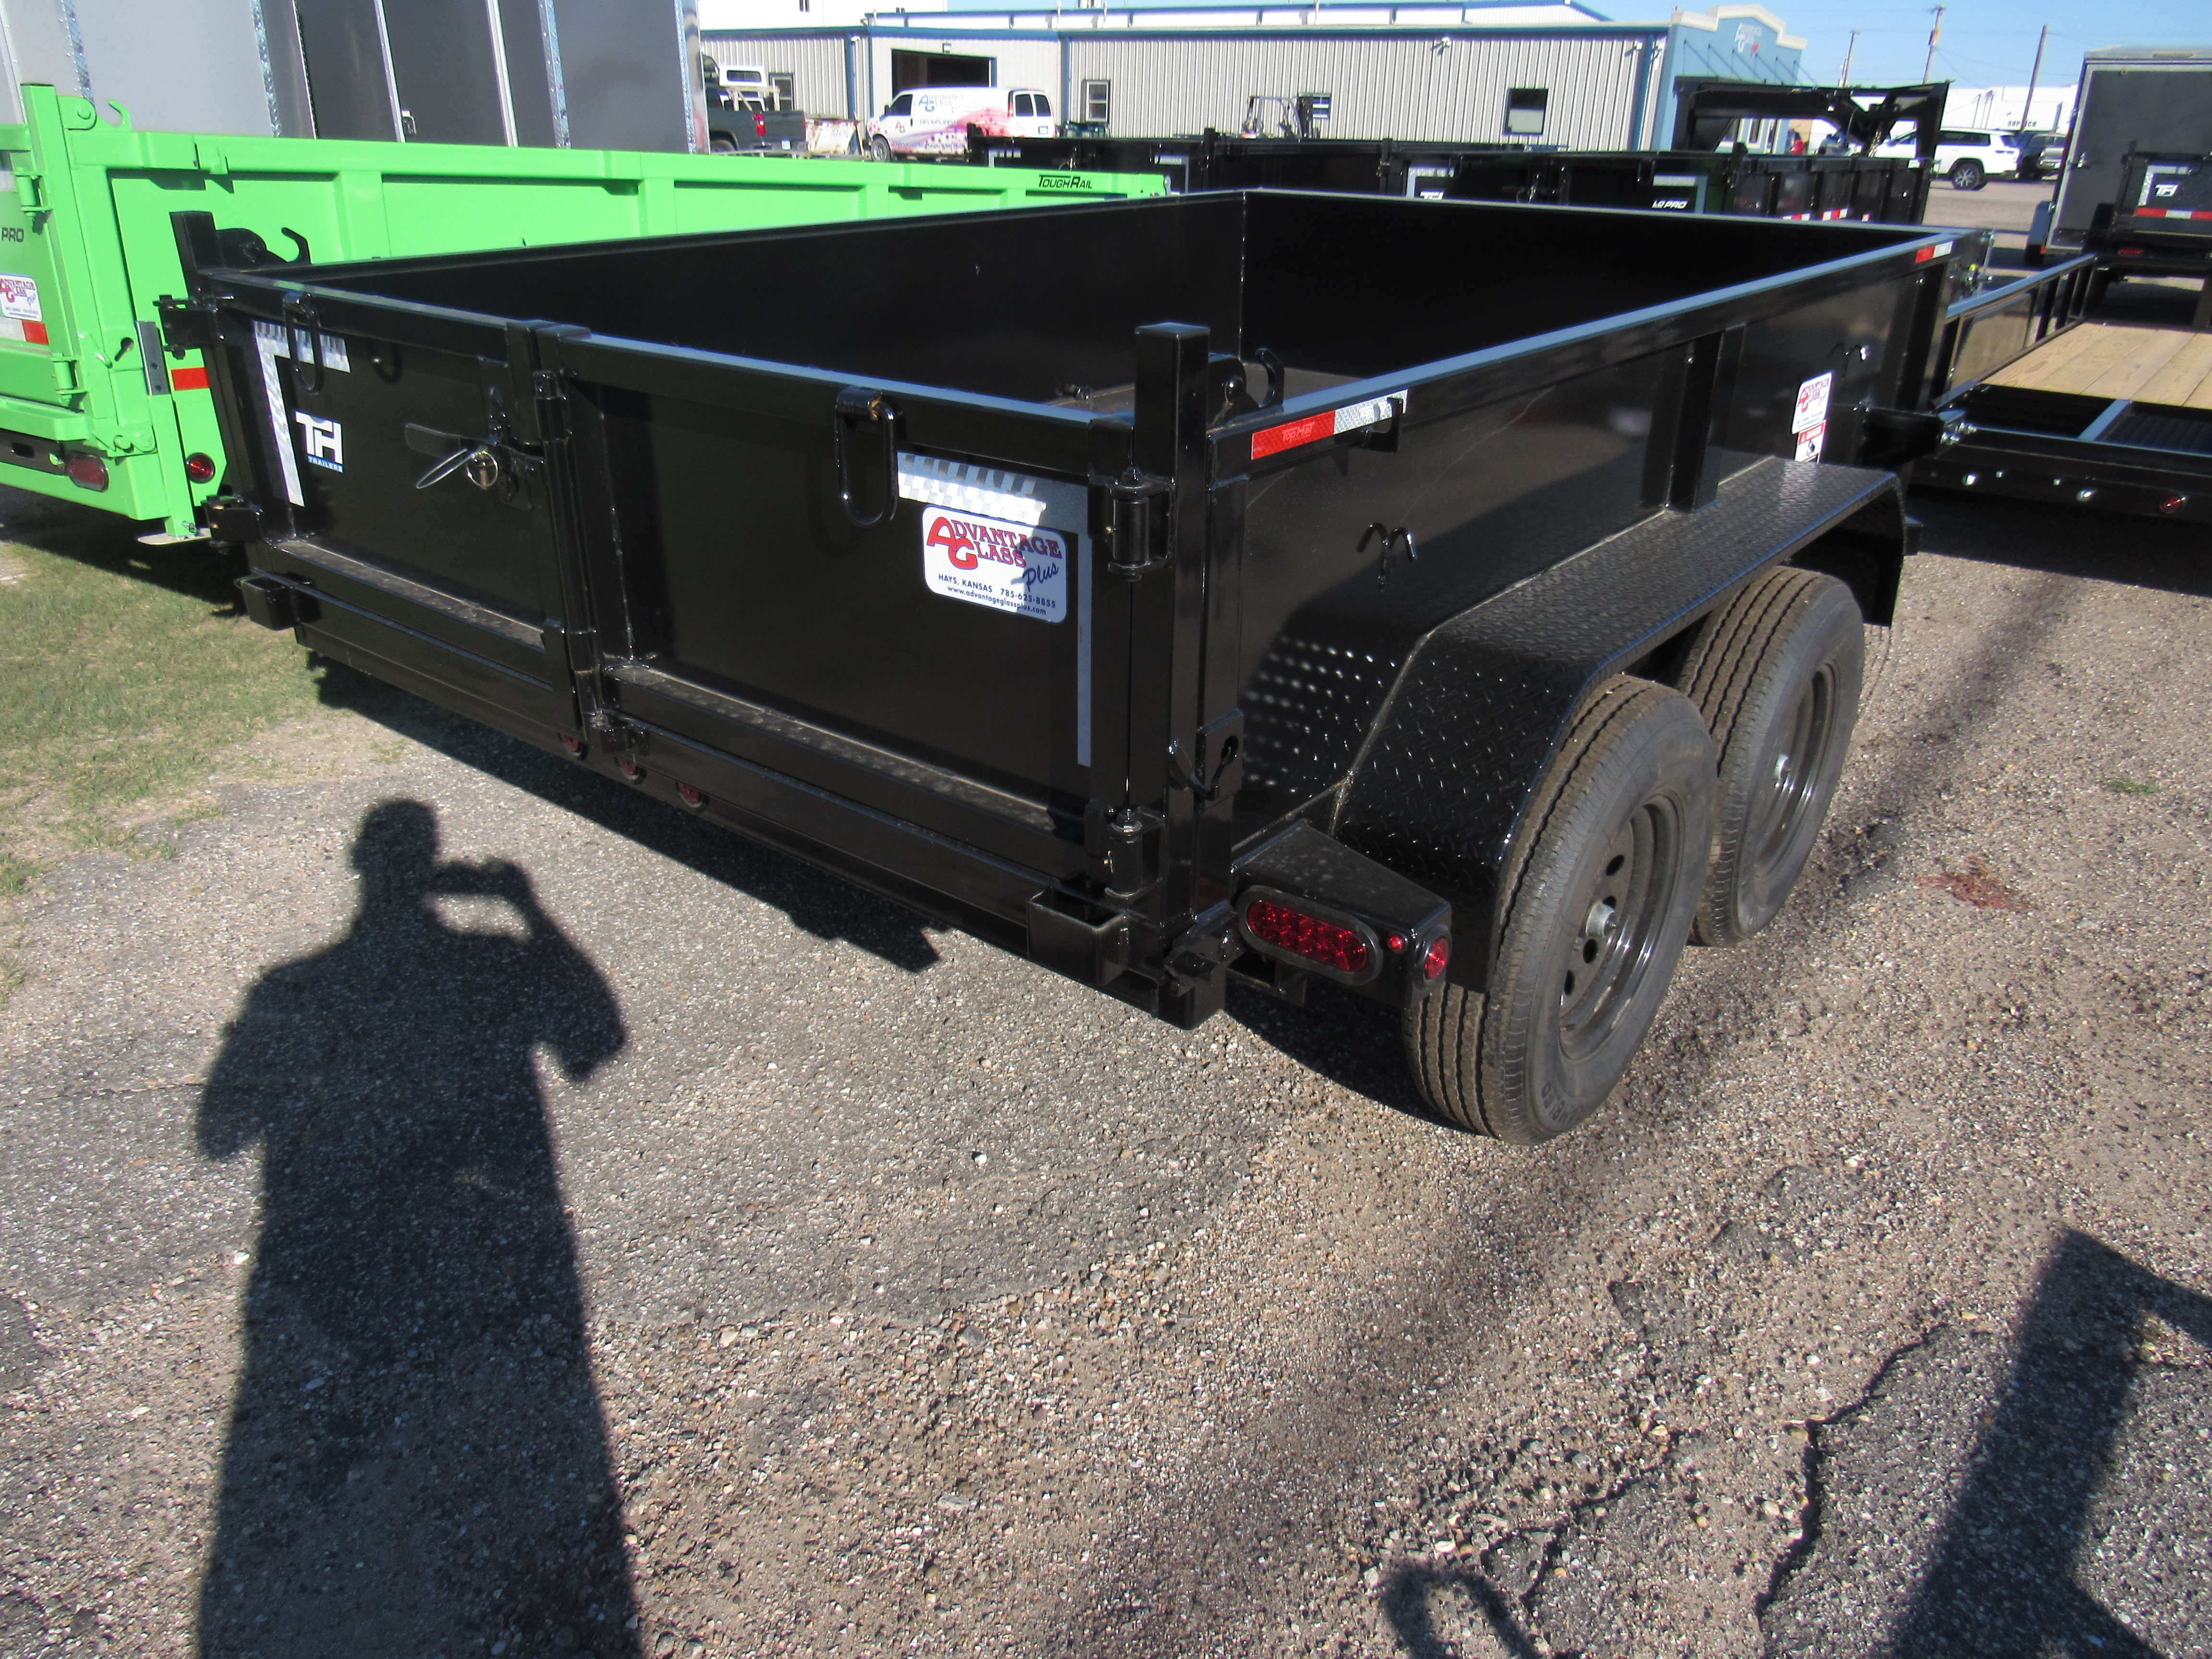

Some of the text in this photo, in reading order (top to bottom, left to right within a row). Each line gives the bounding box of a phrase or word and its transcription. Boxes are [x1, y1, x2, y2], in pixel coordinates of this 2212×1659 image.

[1663, 201, 1688, 209] PRO
[1, 227, 24, 242] PRO
[295, 410, 343, 465] TH
[308, 456, 344, 473] TRAILERS
[926, 517, 1062, 559] ADVANTAGE
[948, 537, 1026, 570] GLASS
[938, 574, 1056, 608] HAYS, KANSAS 785-625-8855
[1022, 562, 1059, 593] Plus
[948, 586, 1046, 615] www.advantageglassplus.com
